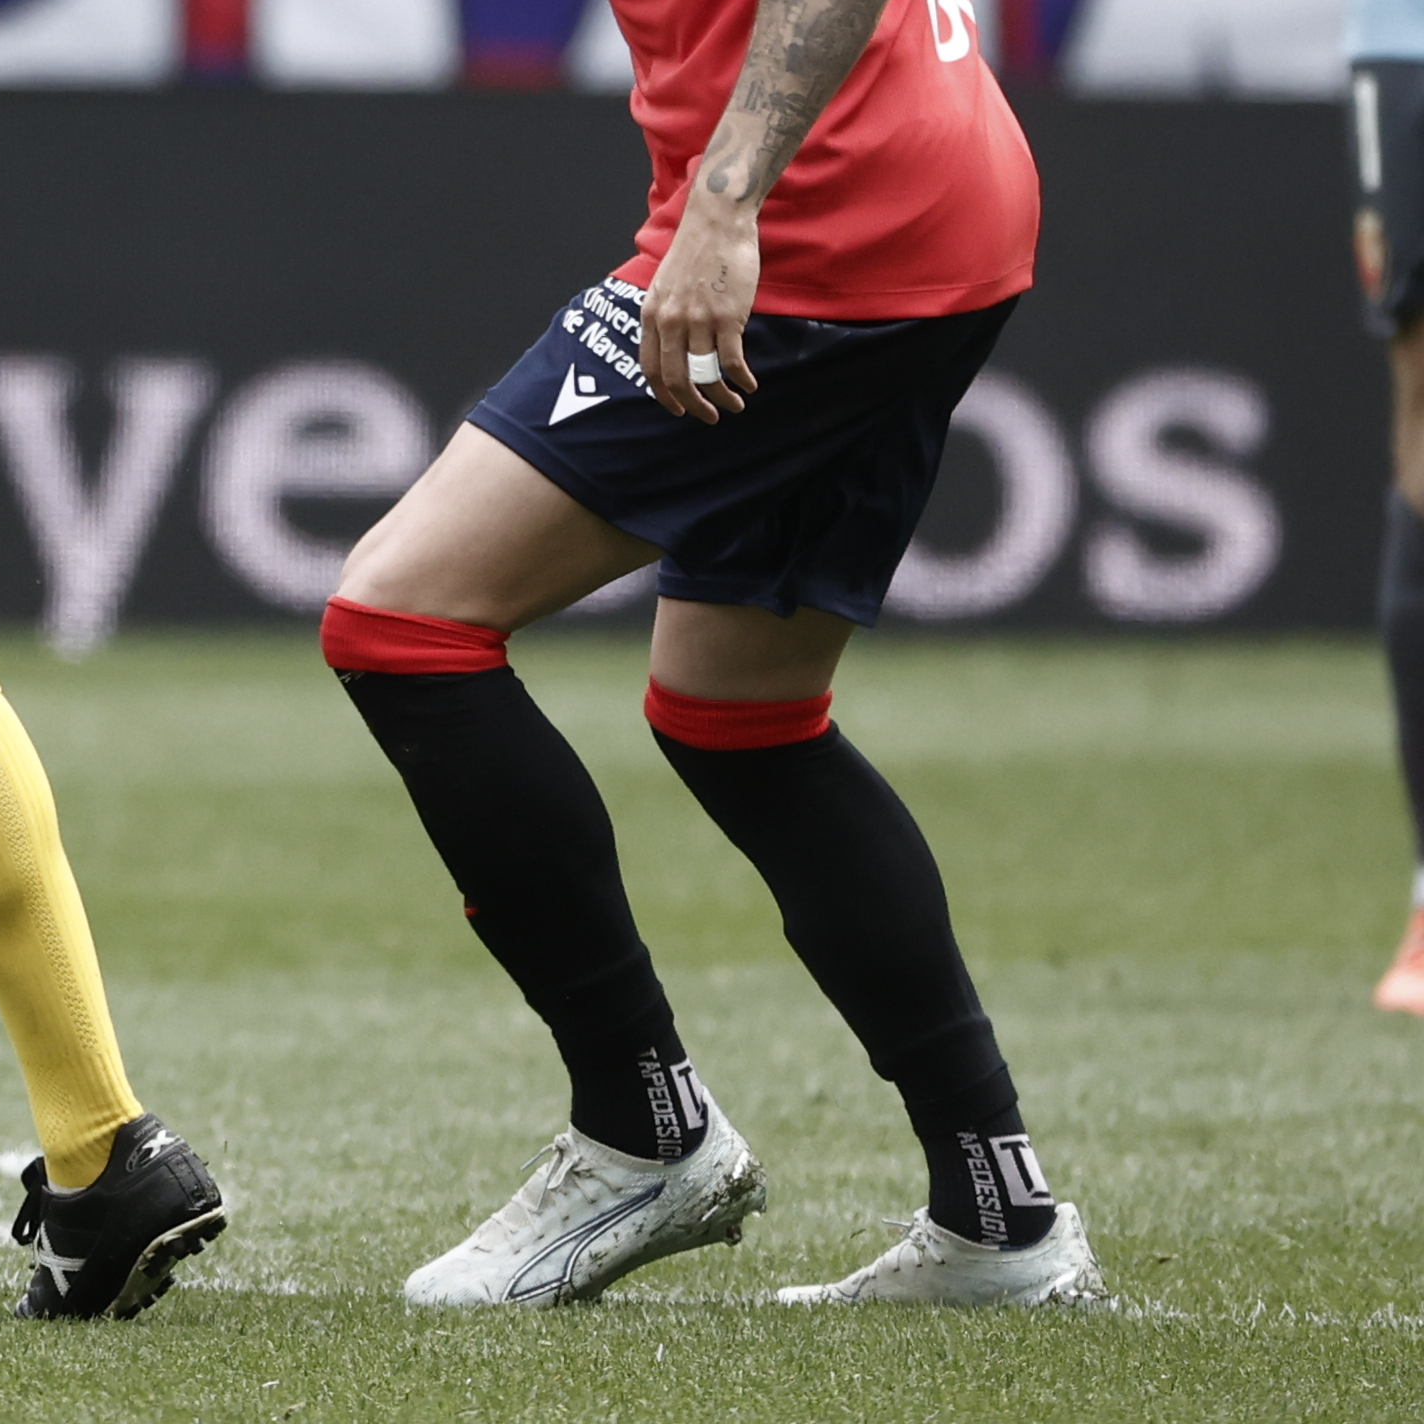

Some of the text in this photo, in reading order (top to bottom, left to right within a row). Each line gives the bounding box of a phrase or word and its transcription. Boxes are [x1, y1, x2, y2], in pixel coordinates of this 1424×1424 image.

[562, 309, 584, 335] de
[582, 287, 643, 345] Univers
[638, 1045, 683, 1161] TAPEDESIG
